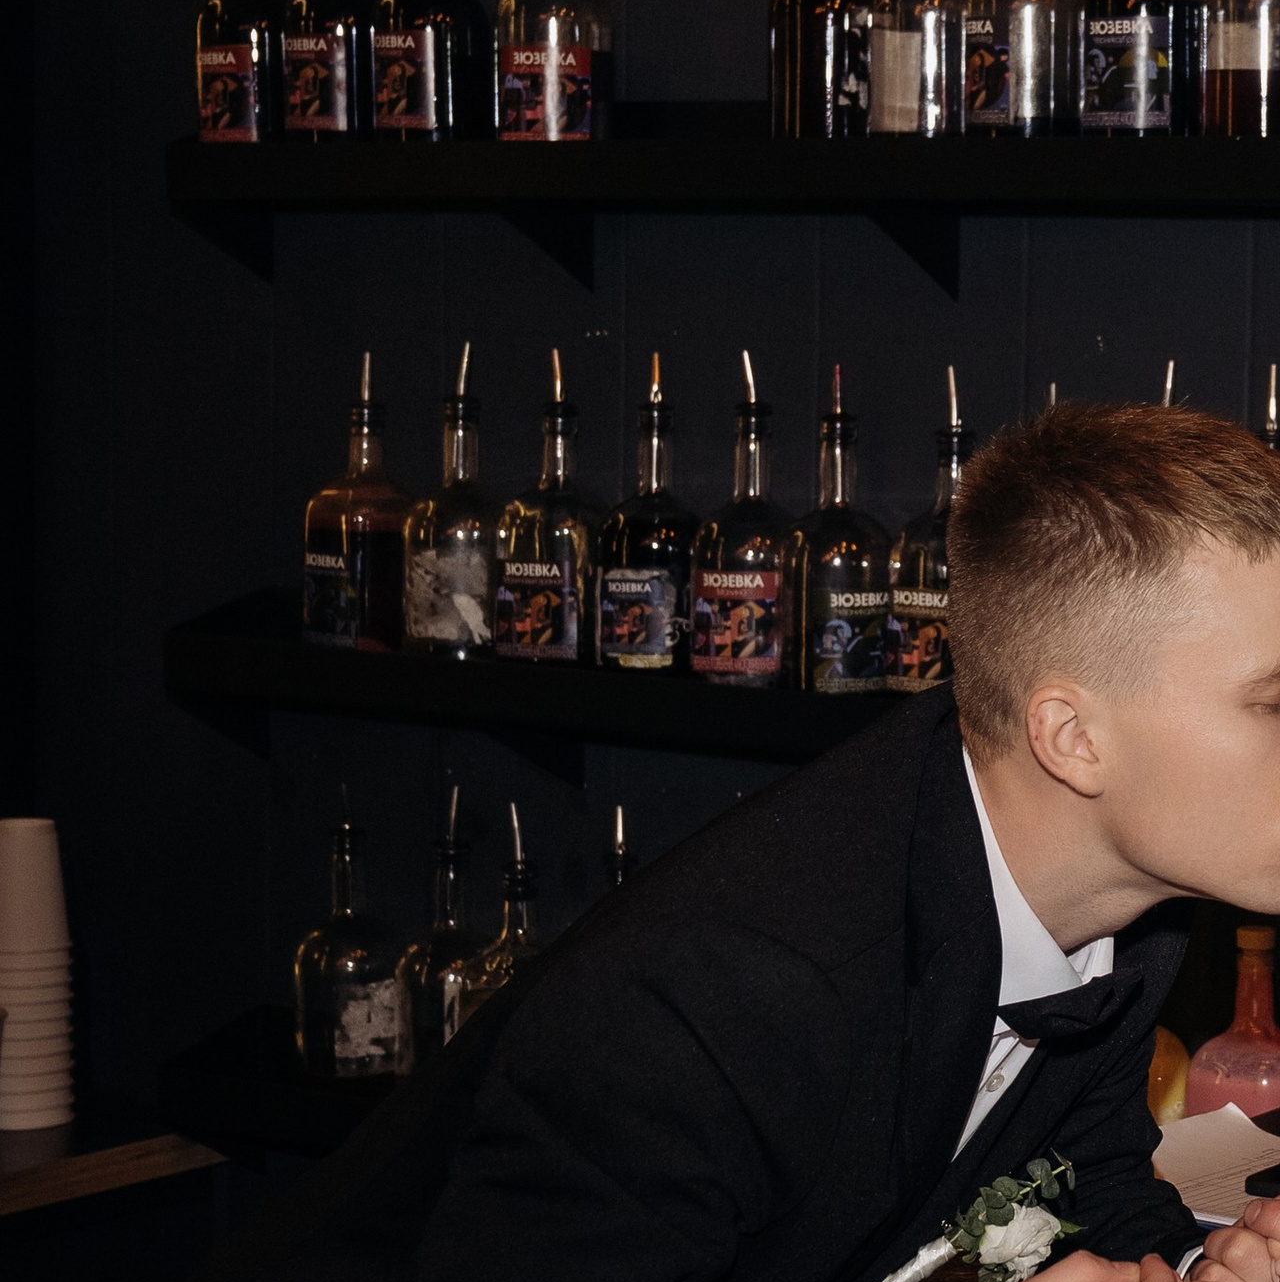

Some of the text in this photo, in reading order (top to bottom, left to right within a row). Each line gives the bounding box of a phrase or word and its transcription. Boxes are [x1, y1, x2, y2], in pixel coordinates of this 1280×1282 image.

[513, 51, 577, 66] ЗЮЗЕКА
[505, 562, 561, 578] ЗЮЗЕВКА
[703, 573, 765, 589] ЗЮЗЕВКА
